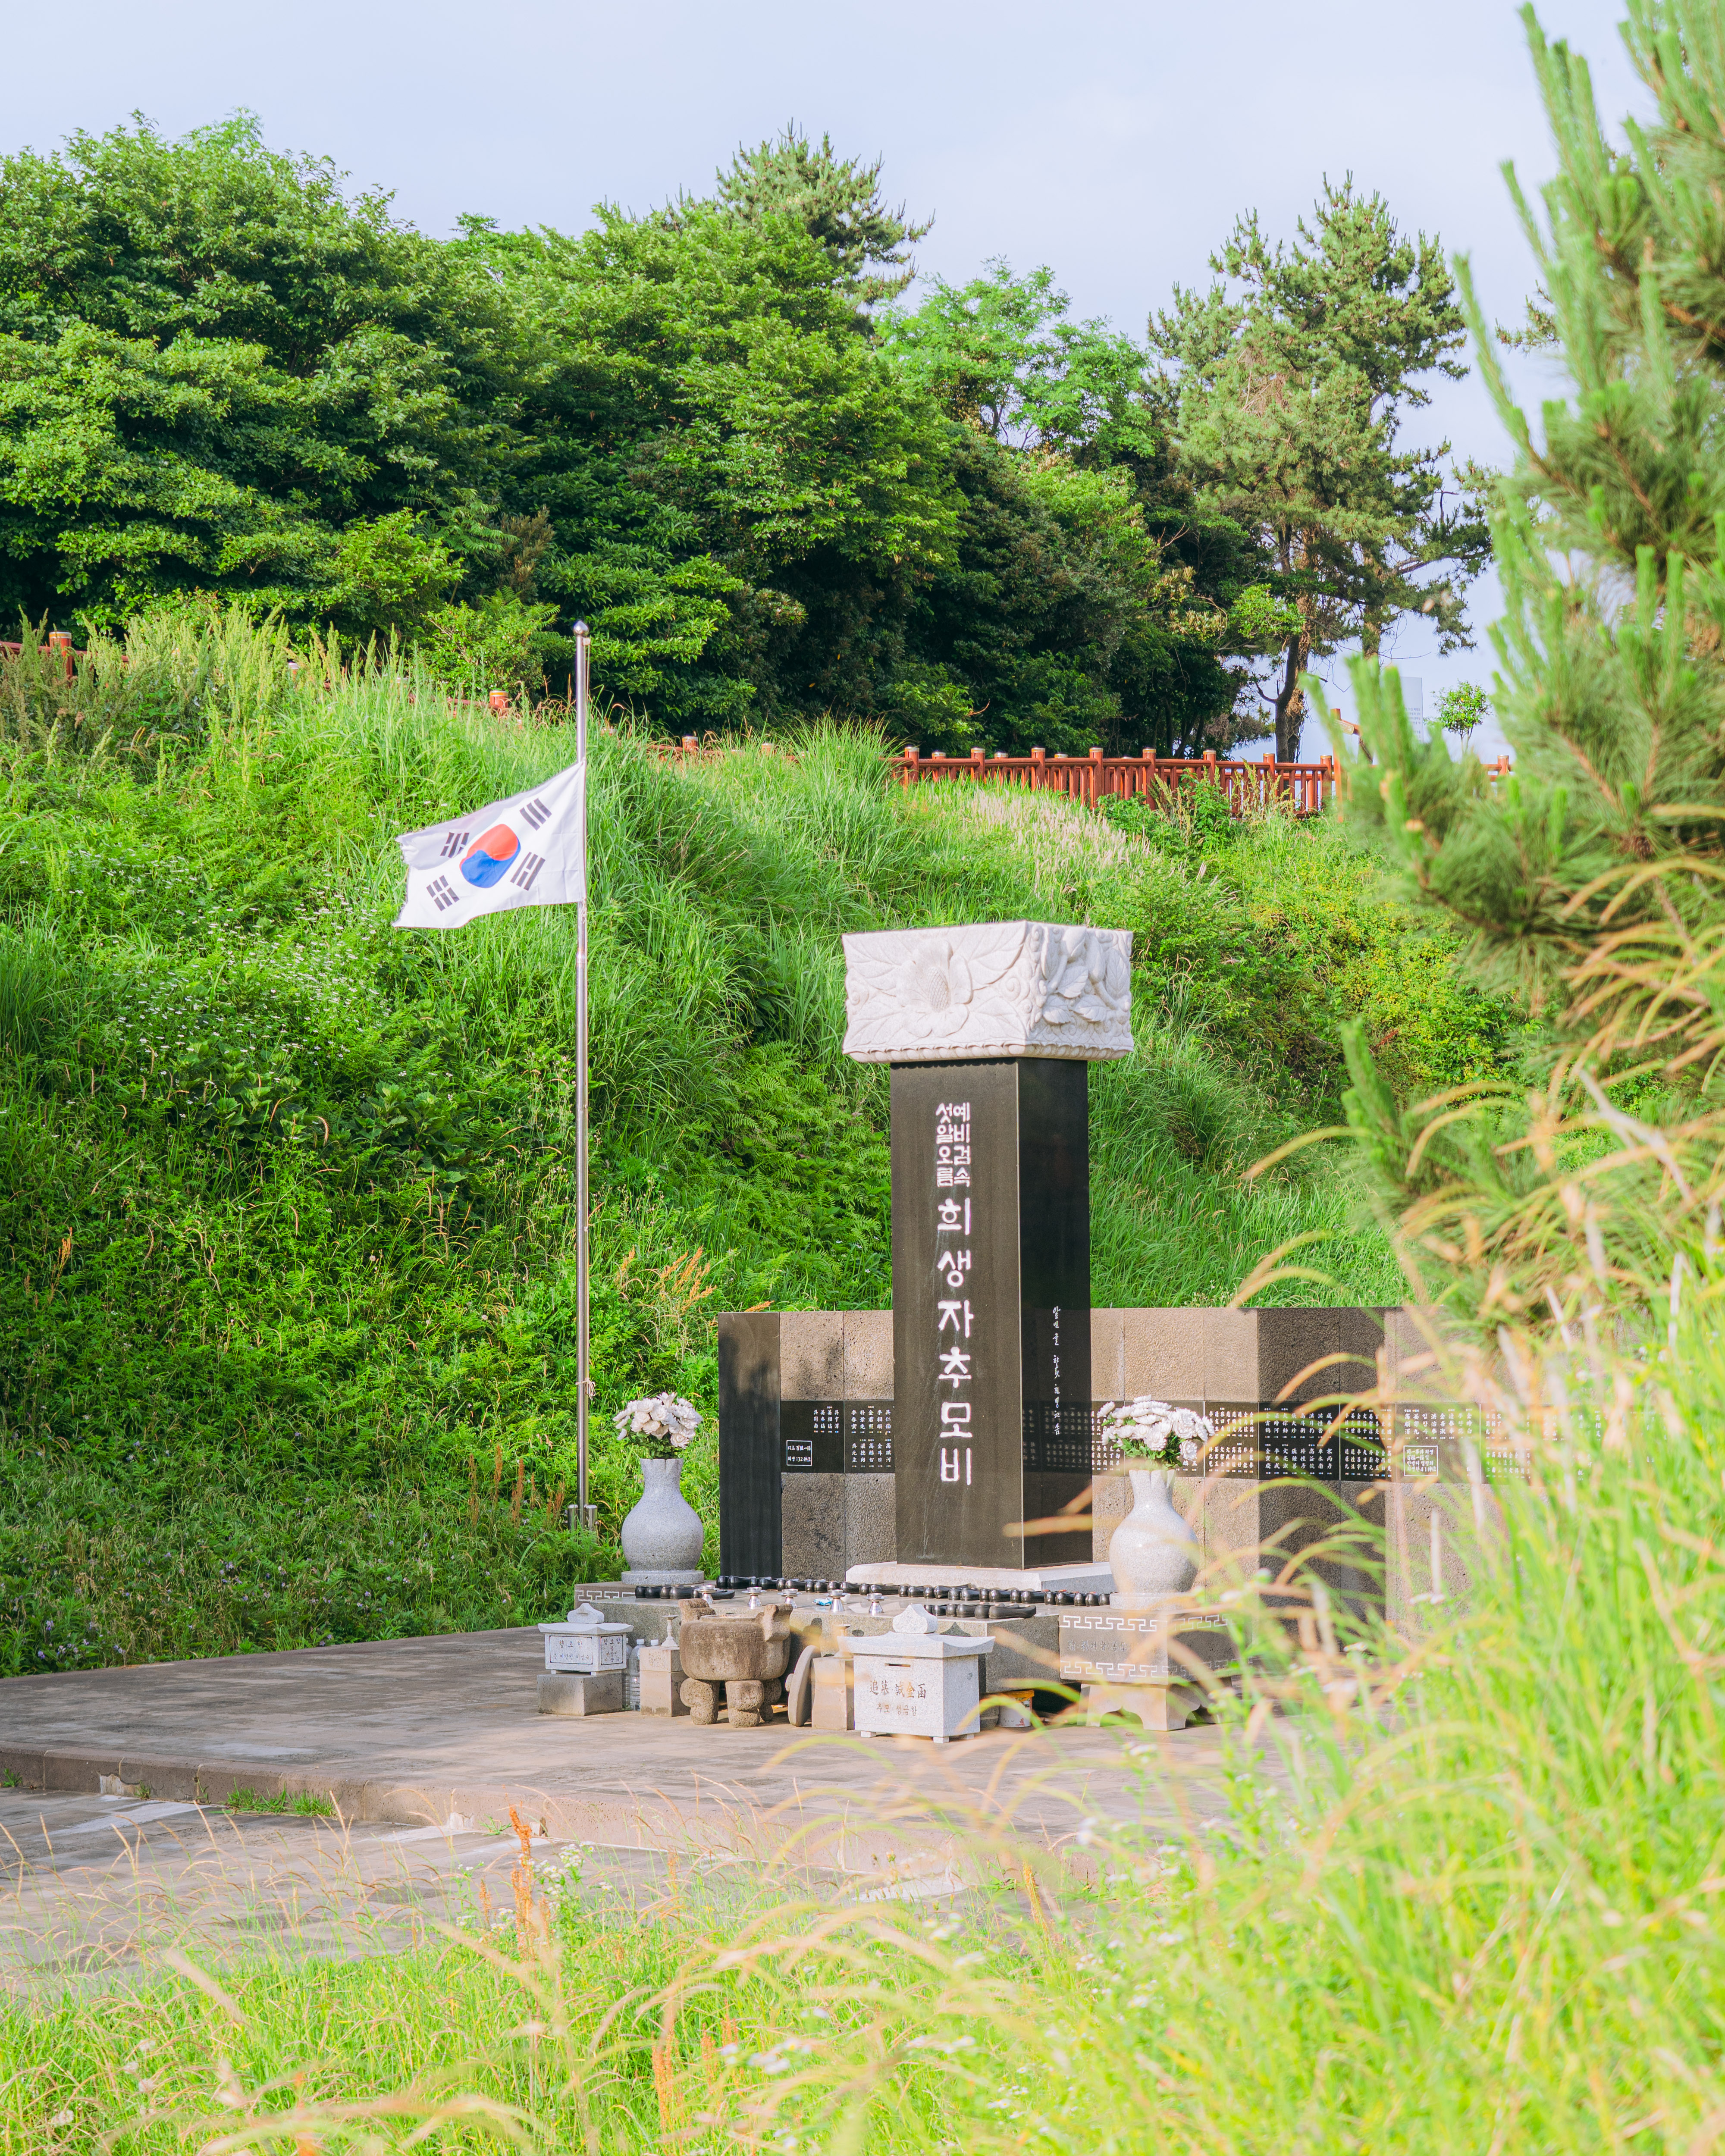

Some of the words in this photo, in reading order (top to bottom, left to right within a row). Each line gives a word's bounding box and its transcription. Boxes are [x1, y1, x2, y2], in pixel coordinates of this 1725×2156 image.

[936, 1103, 953, 1187] 섯알오름
[953, 1102, 971, 1187] 예비검속
[876, 1703, 890, 1713] 추모
[896, 1704, 917, 1716] 성금함
